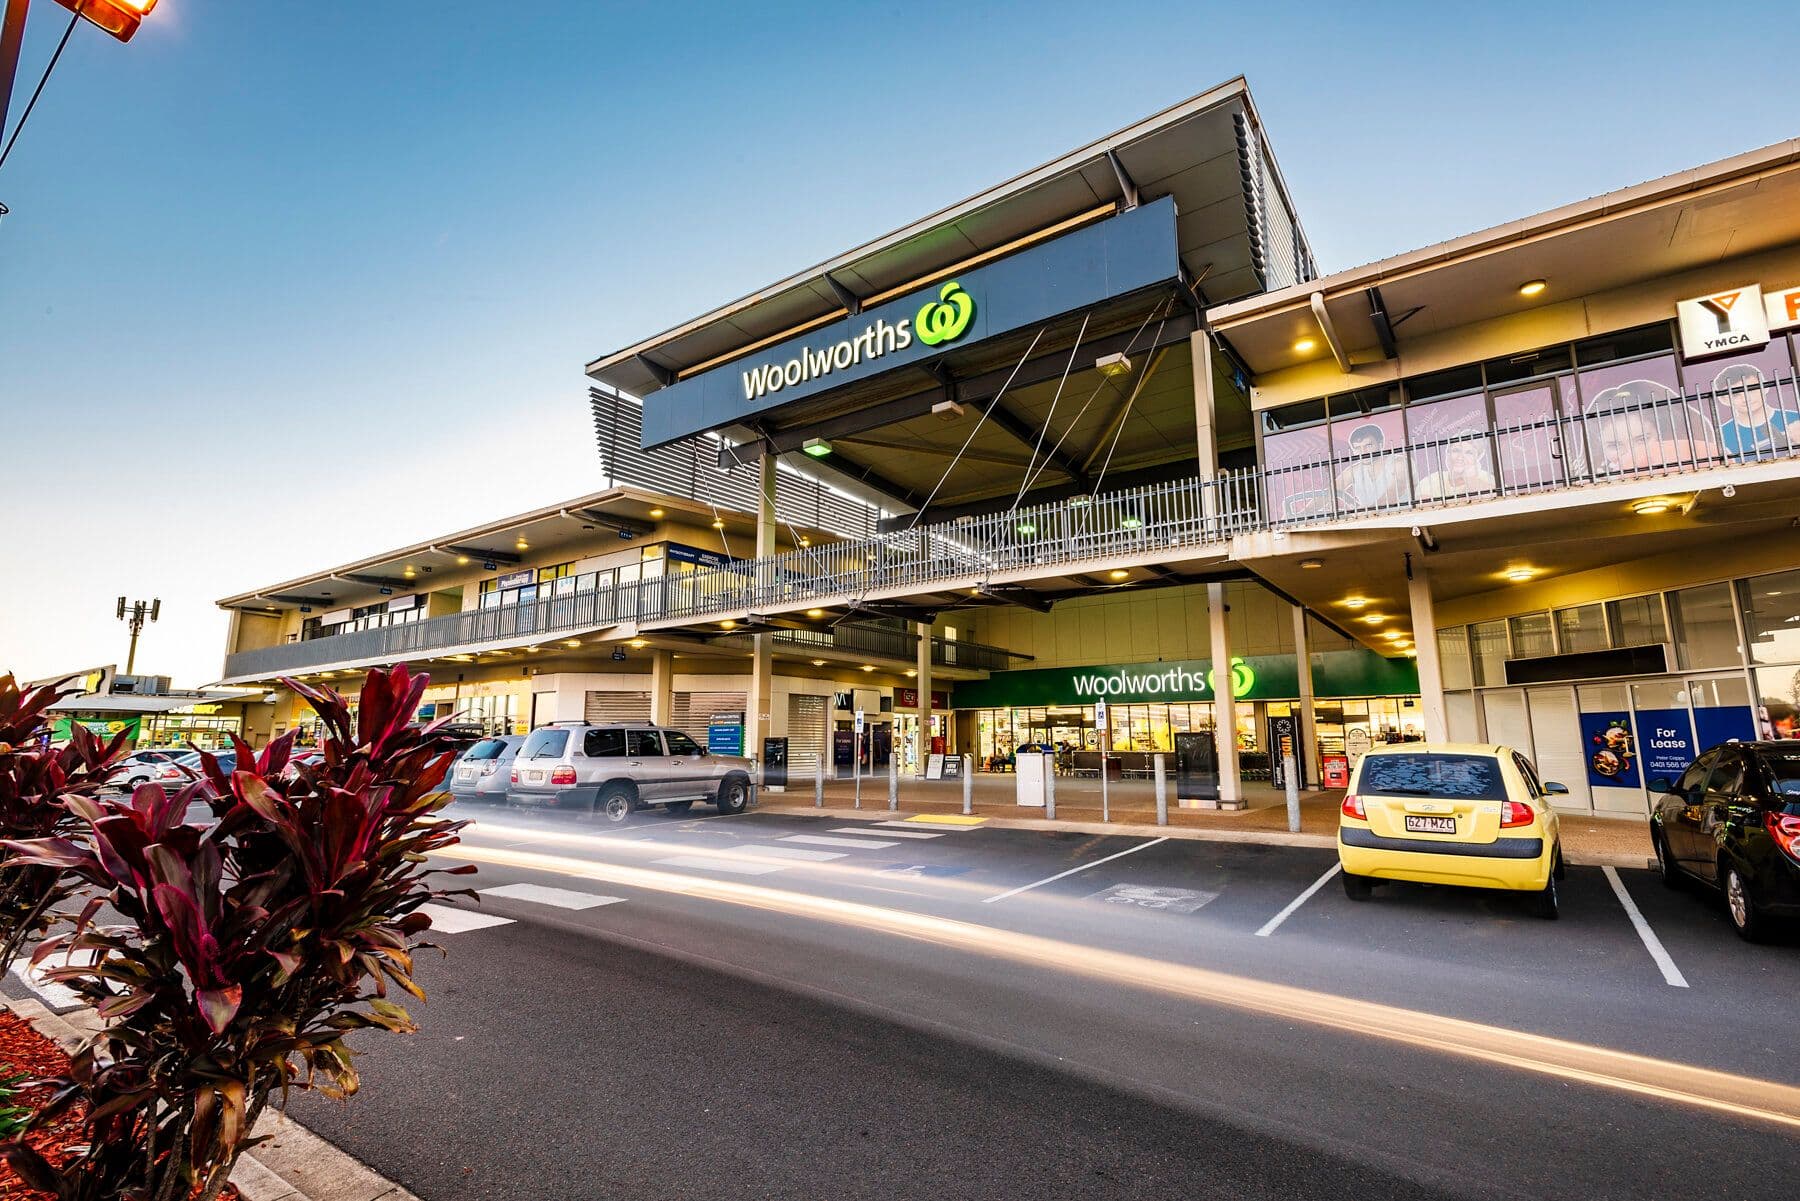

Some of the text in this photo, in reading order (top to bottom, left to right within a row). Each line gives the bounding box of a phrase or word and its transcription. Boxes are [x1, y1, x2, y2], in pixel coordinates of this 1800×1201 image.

[1704, 334, 1750, 349] YMCA
[743, 319, 912, 400] Woolworths
[1073, 667, 1206, 696] Woolworths
[1656, 728, 1676, 737] For
[1650, 739, 1686, 748] Lease
